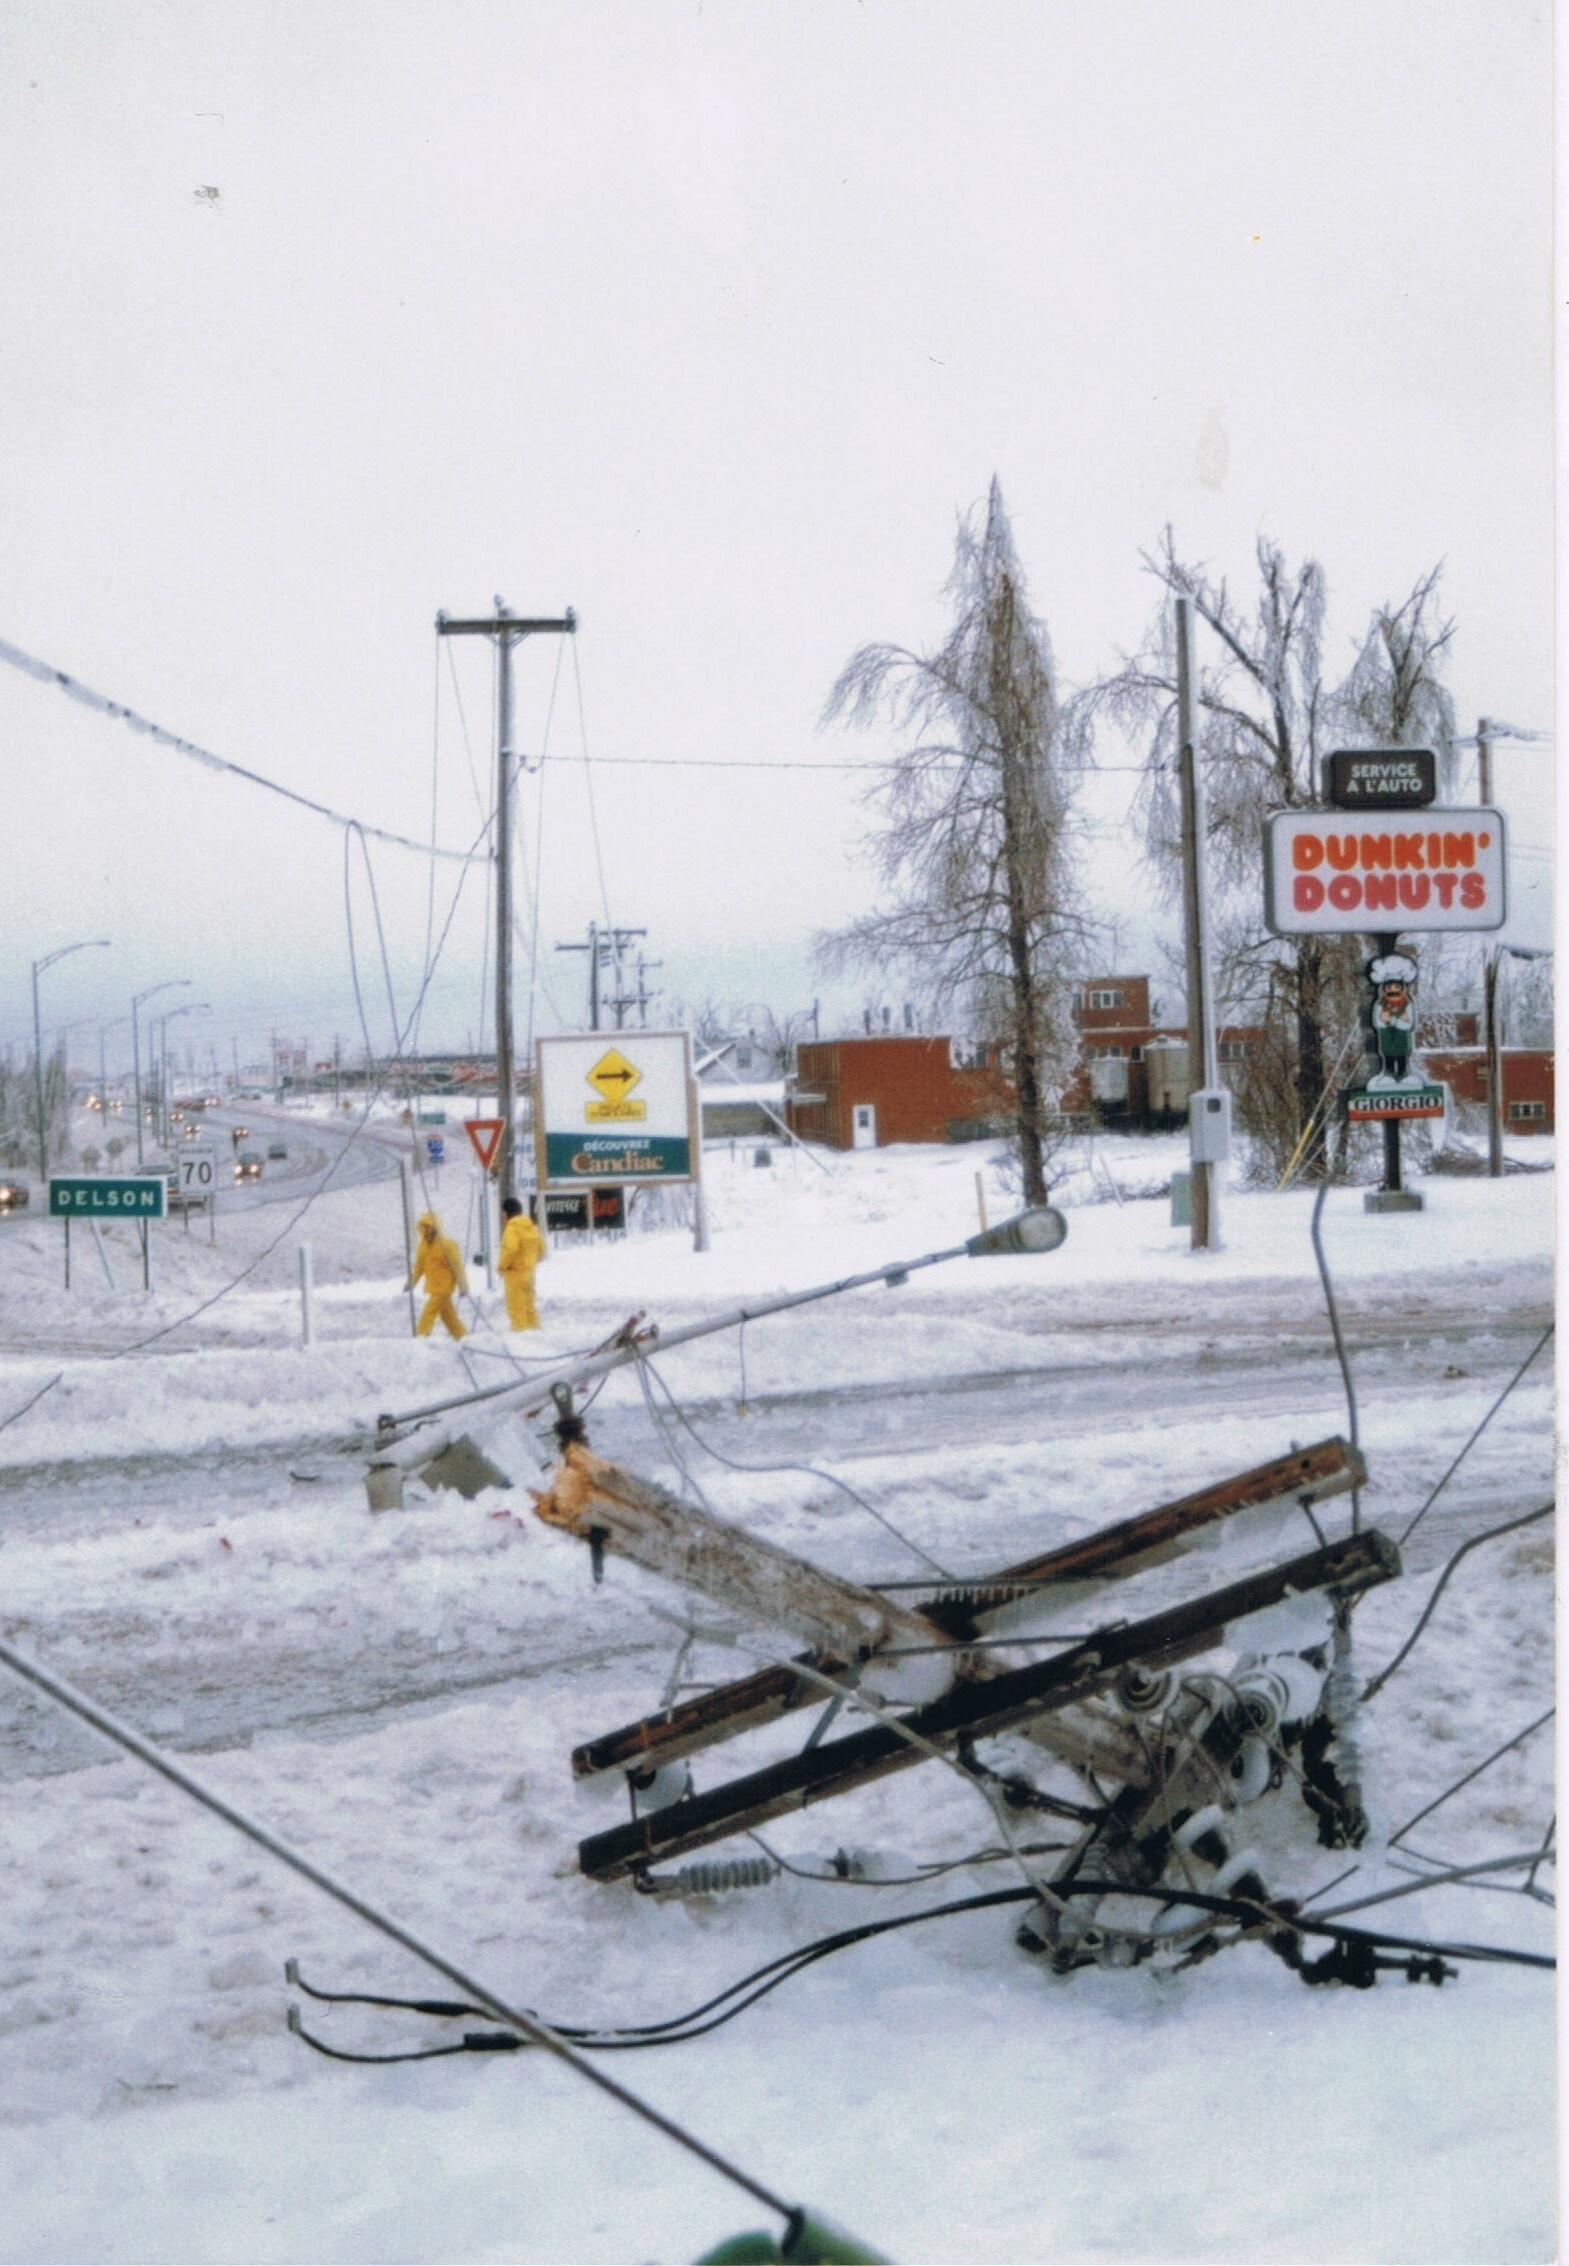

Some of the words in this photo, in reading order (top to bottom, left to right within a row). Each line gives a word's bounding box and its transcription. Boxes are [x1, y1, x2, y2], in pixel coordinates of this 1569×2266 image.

[1350, 763, 1417, 778] SERVICE
[1365, 779, 1422, 793] L'AUTO
[1292, 831, 1490, 872] DUNKIN'
[1293, 872, 1486, 913] DONUTS
[1354, 1095, 1439, 1112] GIORGIO
[571, 1150, 664, 1174] Candiac
[182, 1161, 212, 1185] 70
[58, 1190, 155, 1206] DELSON
